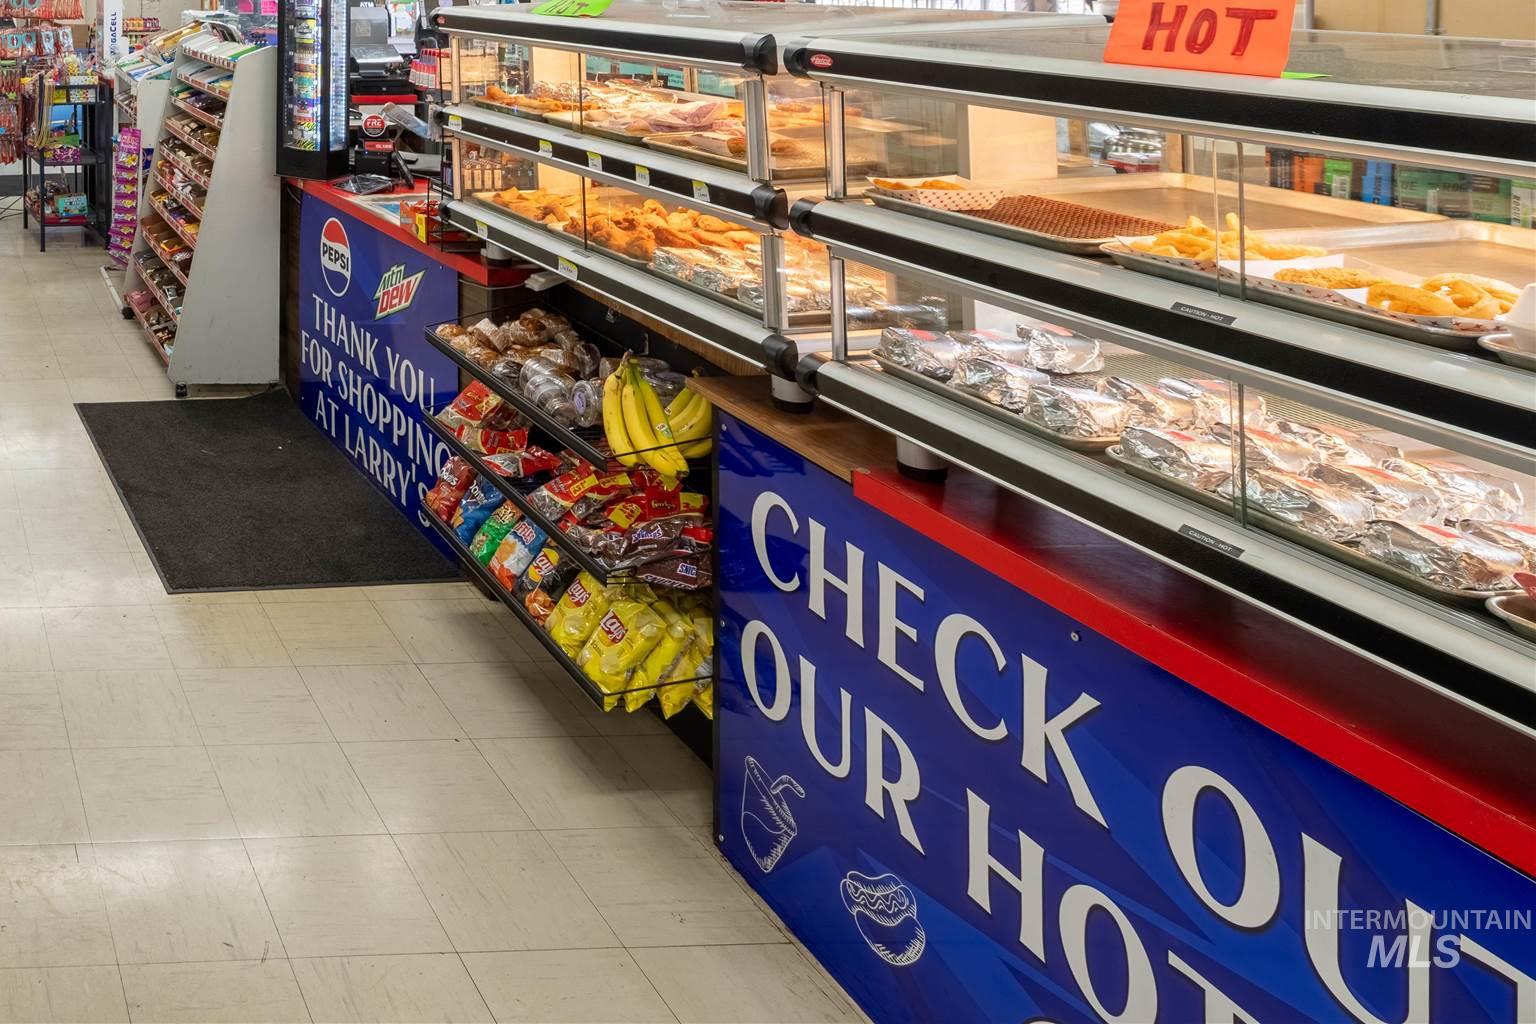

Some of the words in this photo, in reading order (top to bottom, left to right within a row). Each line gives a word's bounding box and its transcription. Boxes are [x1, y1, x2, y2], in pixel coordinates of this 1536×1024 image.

[1141, 2, 1278, 57] HOT
[322, 242, 349, 272] PEPSI
[1180, 306, 1207, 318] CAUTION
[1210, 314, 1224, 322] HOT
[302, 330, 333, 389] FOR
[313, 293, 379, 378] THANK
[386, 346, 434, 416] YOU
[315, 390, 339, 439] AT
[1188, 530, 1216, 545] CAUTION
[1217, 543, 1233, 553] HOT
[751, 490, 1112, 830] CHECK
[740, 619, 926, 856] OUR
